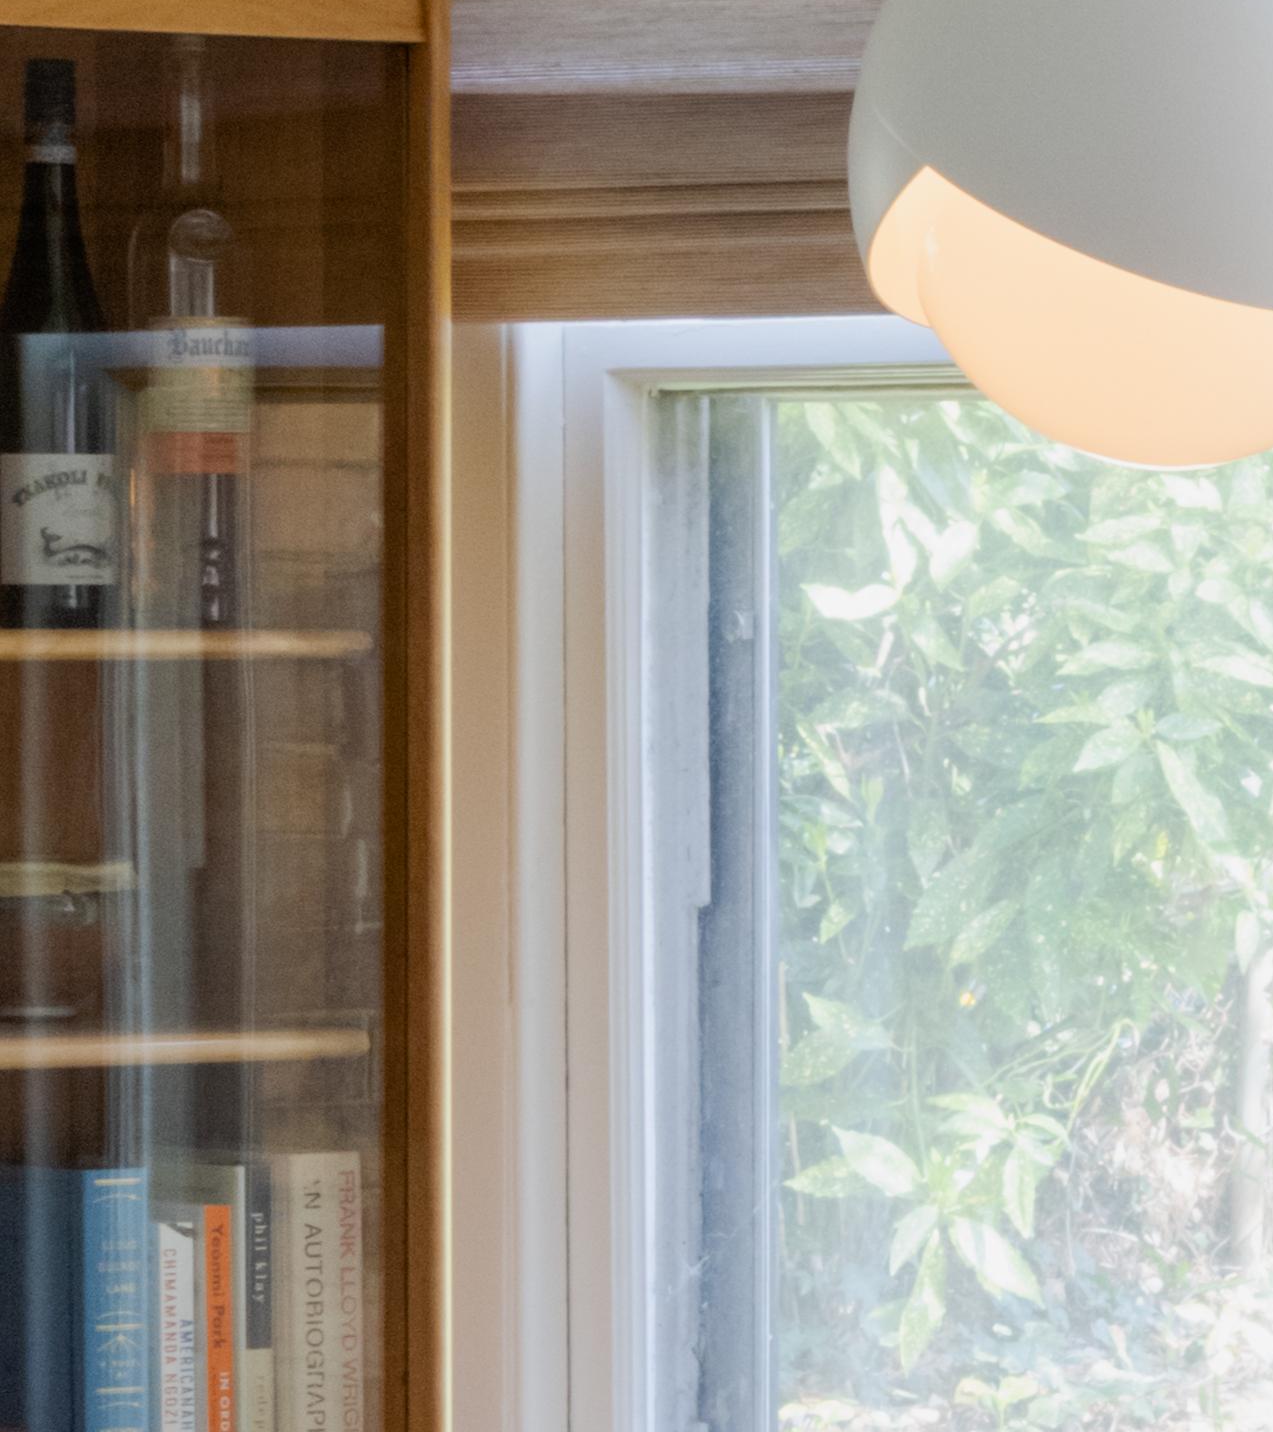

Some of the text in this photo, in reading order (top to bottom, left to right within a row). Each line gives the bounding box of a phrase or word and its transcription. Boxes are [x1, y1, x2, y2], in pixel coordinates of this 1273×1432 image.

[338, 1170, 357, 1258] FRANK
[250, 1211, 268, 1304] phil klay
[162, 1248, 177, 1365] CHIMAMANDA
[213, 1304, 227, 1349] Park
[340, 1267, 358, 1351] LLOYD
[163, 1373, 178, 1425] NGOZI
[179, 1319, 195, 1430] AMERICANAH
[219, 1372, 230, 1391] IN
